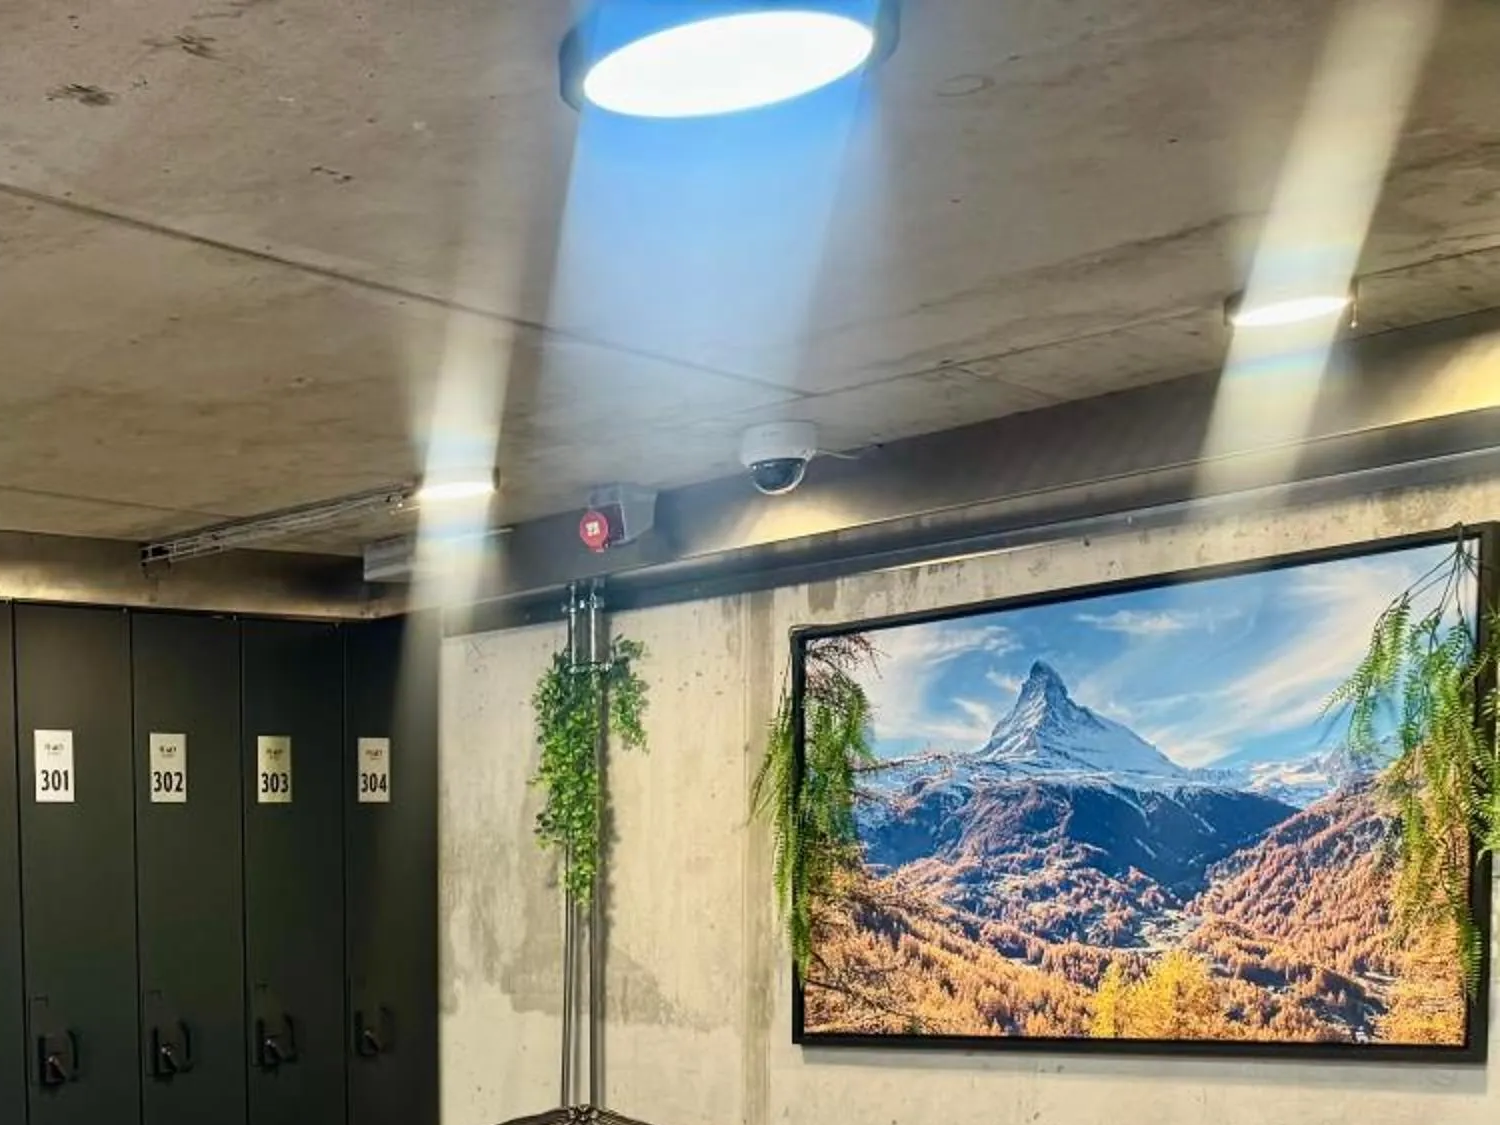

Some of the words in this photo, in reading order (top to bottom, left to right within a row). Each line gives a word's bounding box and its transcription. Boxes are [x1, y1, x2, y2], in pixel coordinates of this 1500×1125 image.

[40, 769, 70, 792] 301
[153, 771, 184, 793] 302
[261, 772, 290, 793] 303
[360, 772, 388, 794] 304
